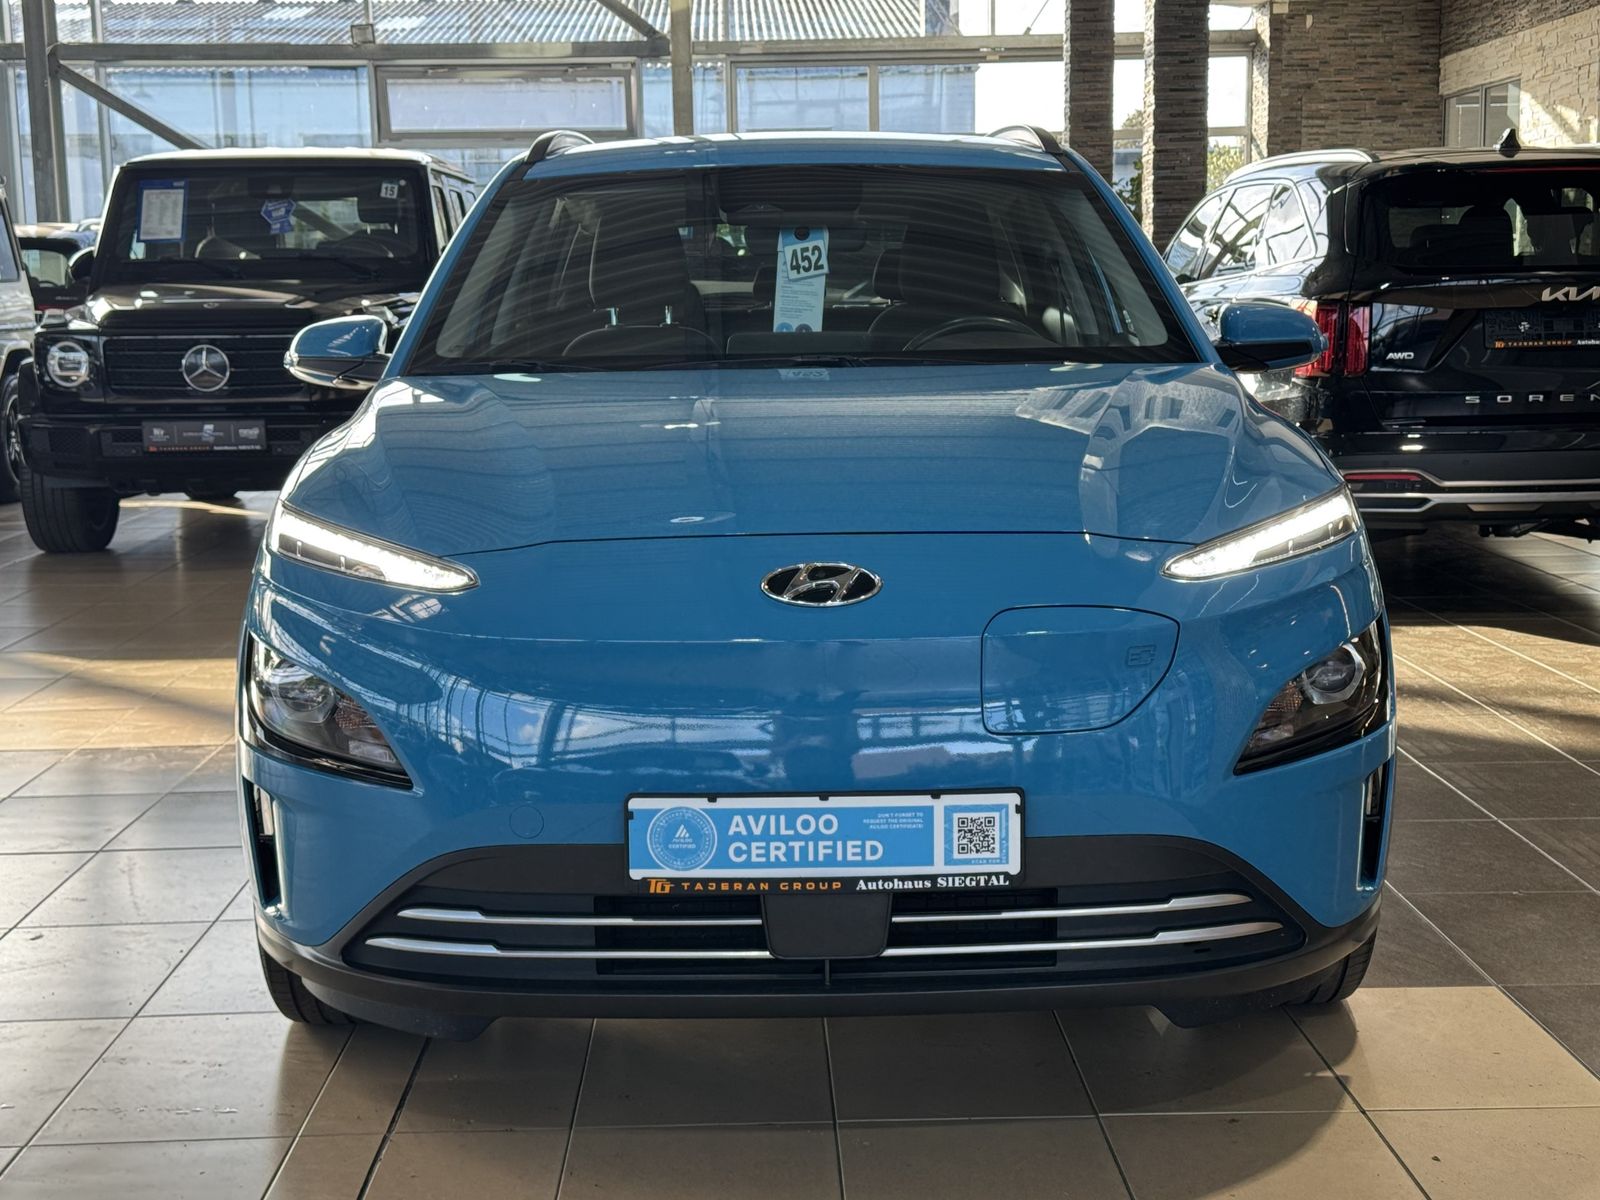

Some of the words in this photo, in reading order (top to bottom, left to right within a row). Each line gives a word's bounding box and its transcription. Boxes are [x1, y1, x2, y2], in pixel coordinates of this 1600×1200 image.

[383, 185, 396, 197] 15
[790, 245, 824, 275] 452
[1386, 352, 1414, 360] AWD
[728, 814, 838, 835] AVILOO
[728, 841, 883, 862] CERTIFIED
[681, 881, 769, 891] TAJERAN
[780, 880, 842, 891] GROUP
[856, 879, 931, 891] Autohaus
[937, 875, 1009, 888] SIEGTAL
